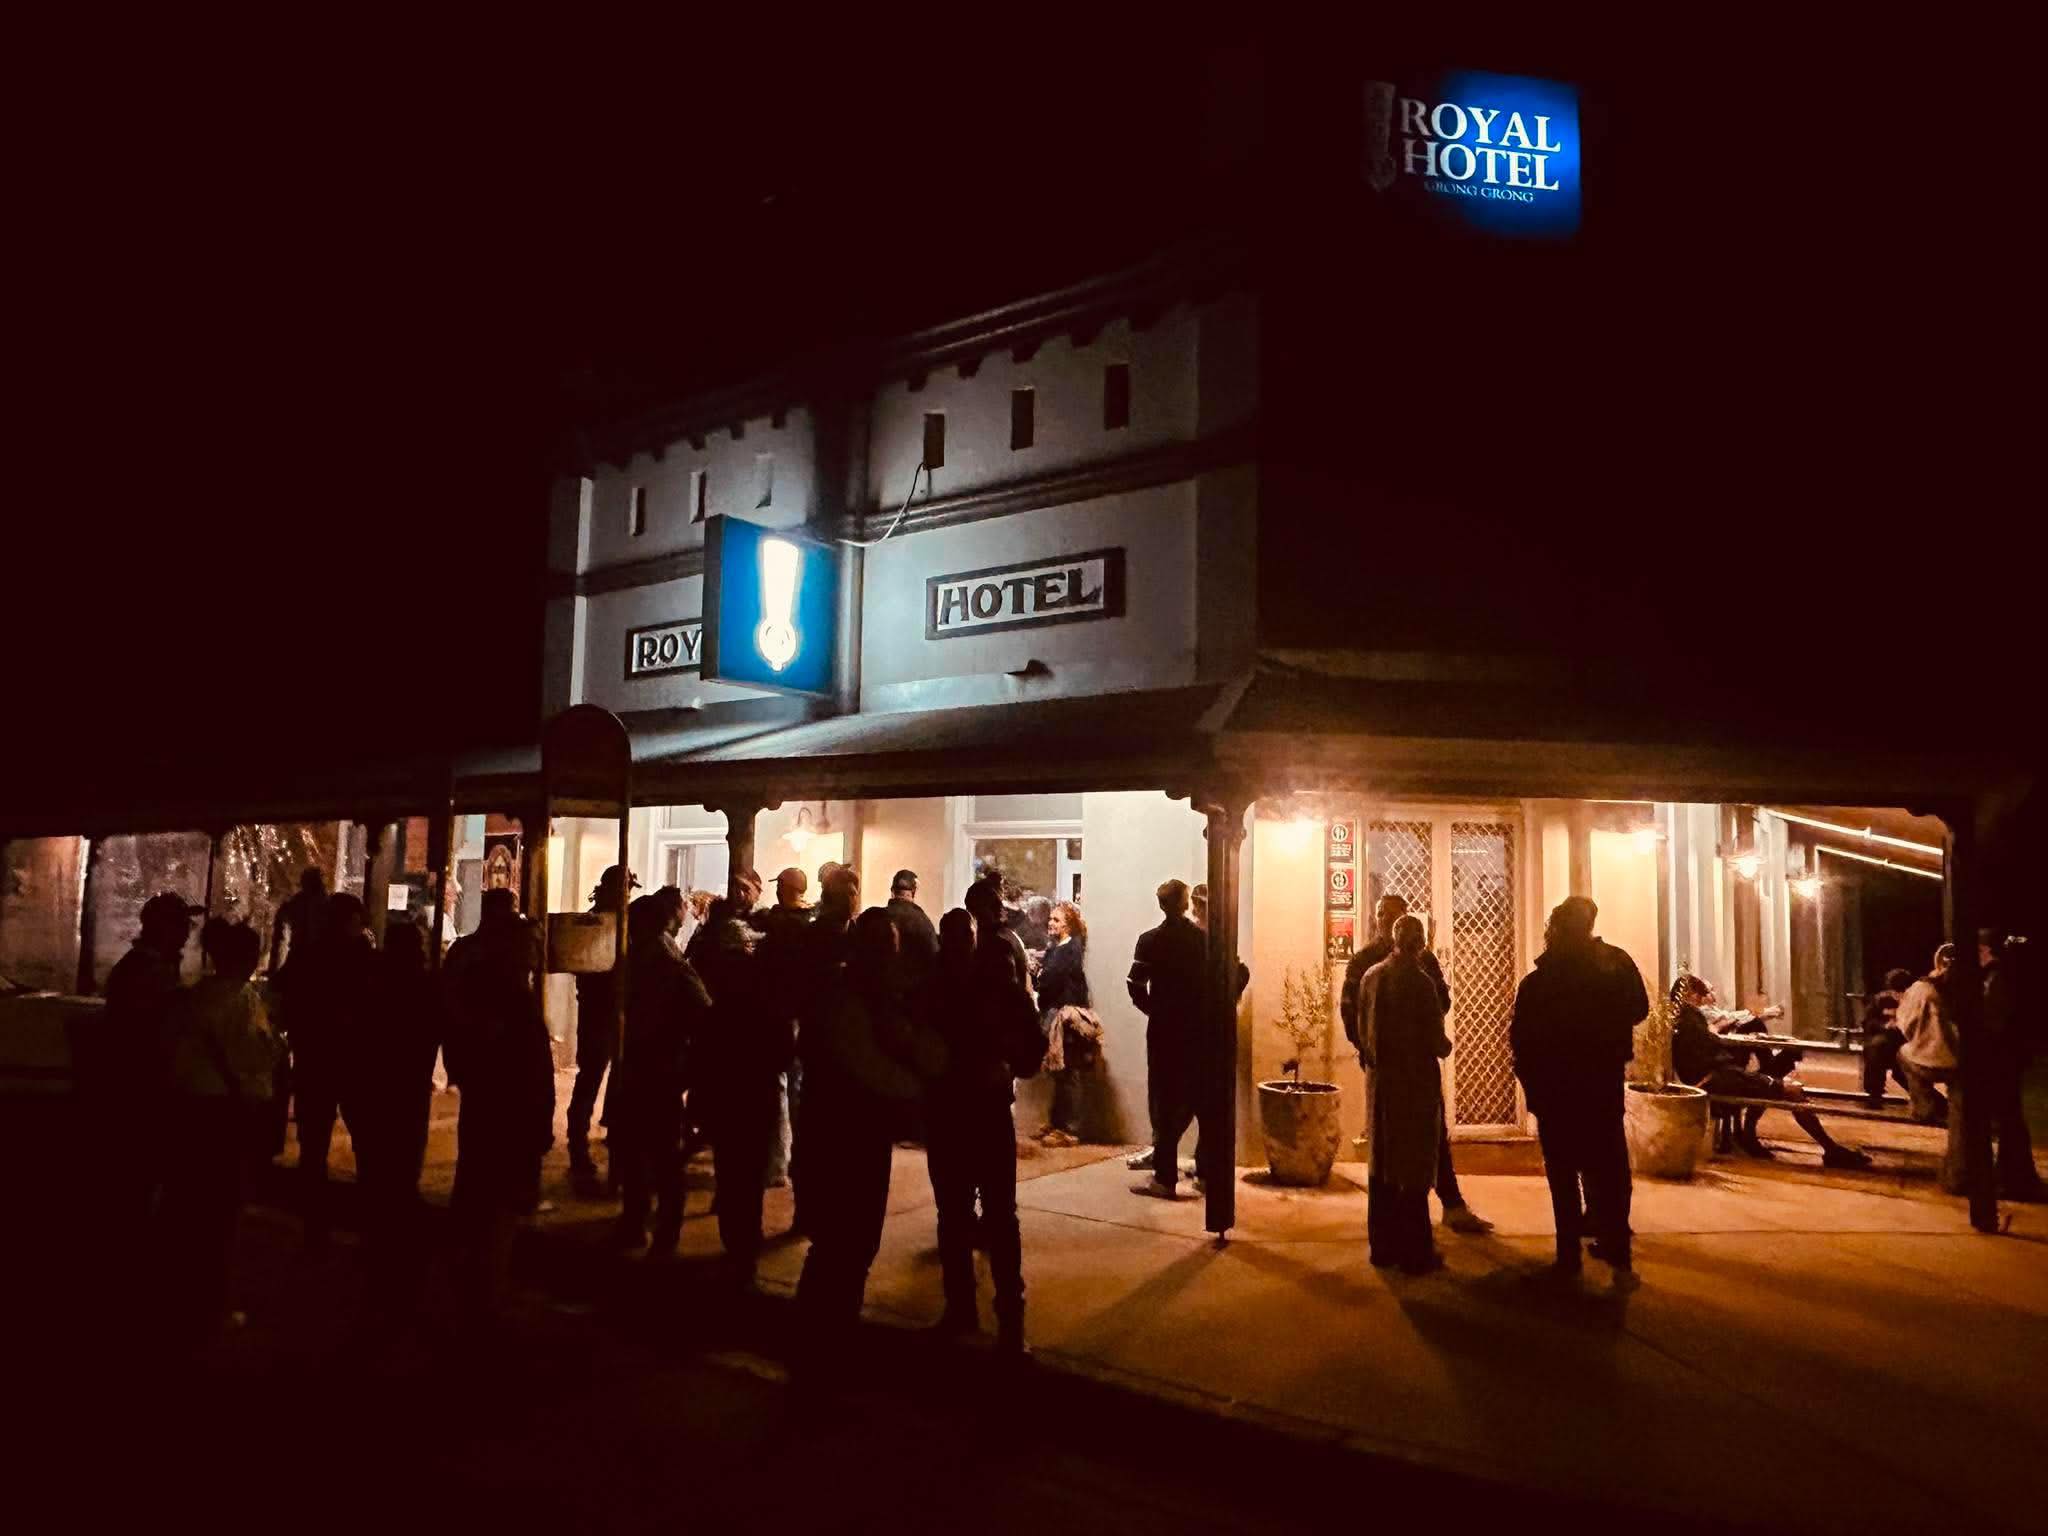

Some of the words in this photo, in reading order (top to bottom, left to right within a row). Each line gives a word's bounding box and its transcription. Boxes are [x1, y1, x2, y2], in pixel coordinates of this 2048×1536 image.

[1400, 98, 1561, 152] ROYAL
[1402, 139, 1560, 191] HOTEL
[1424, 182, 1477, 196] GRONG
[1480, 187, 1534, 203] GRONG
[638, 629, 703, 668] ROY
[938, 567, 1103, 625] HOTEL
